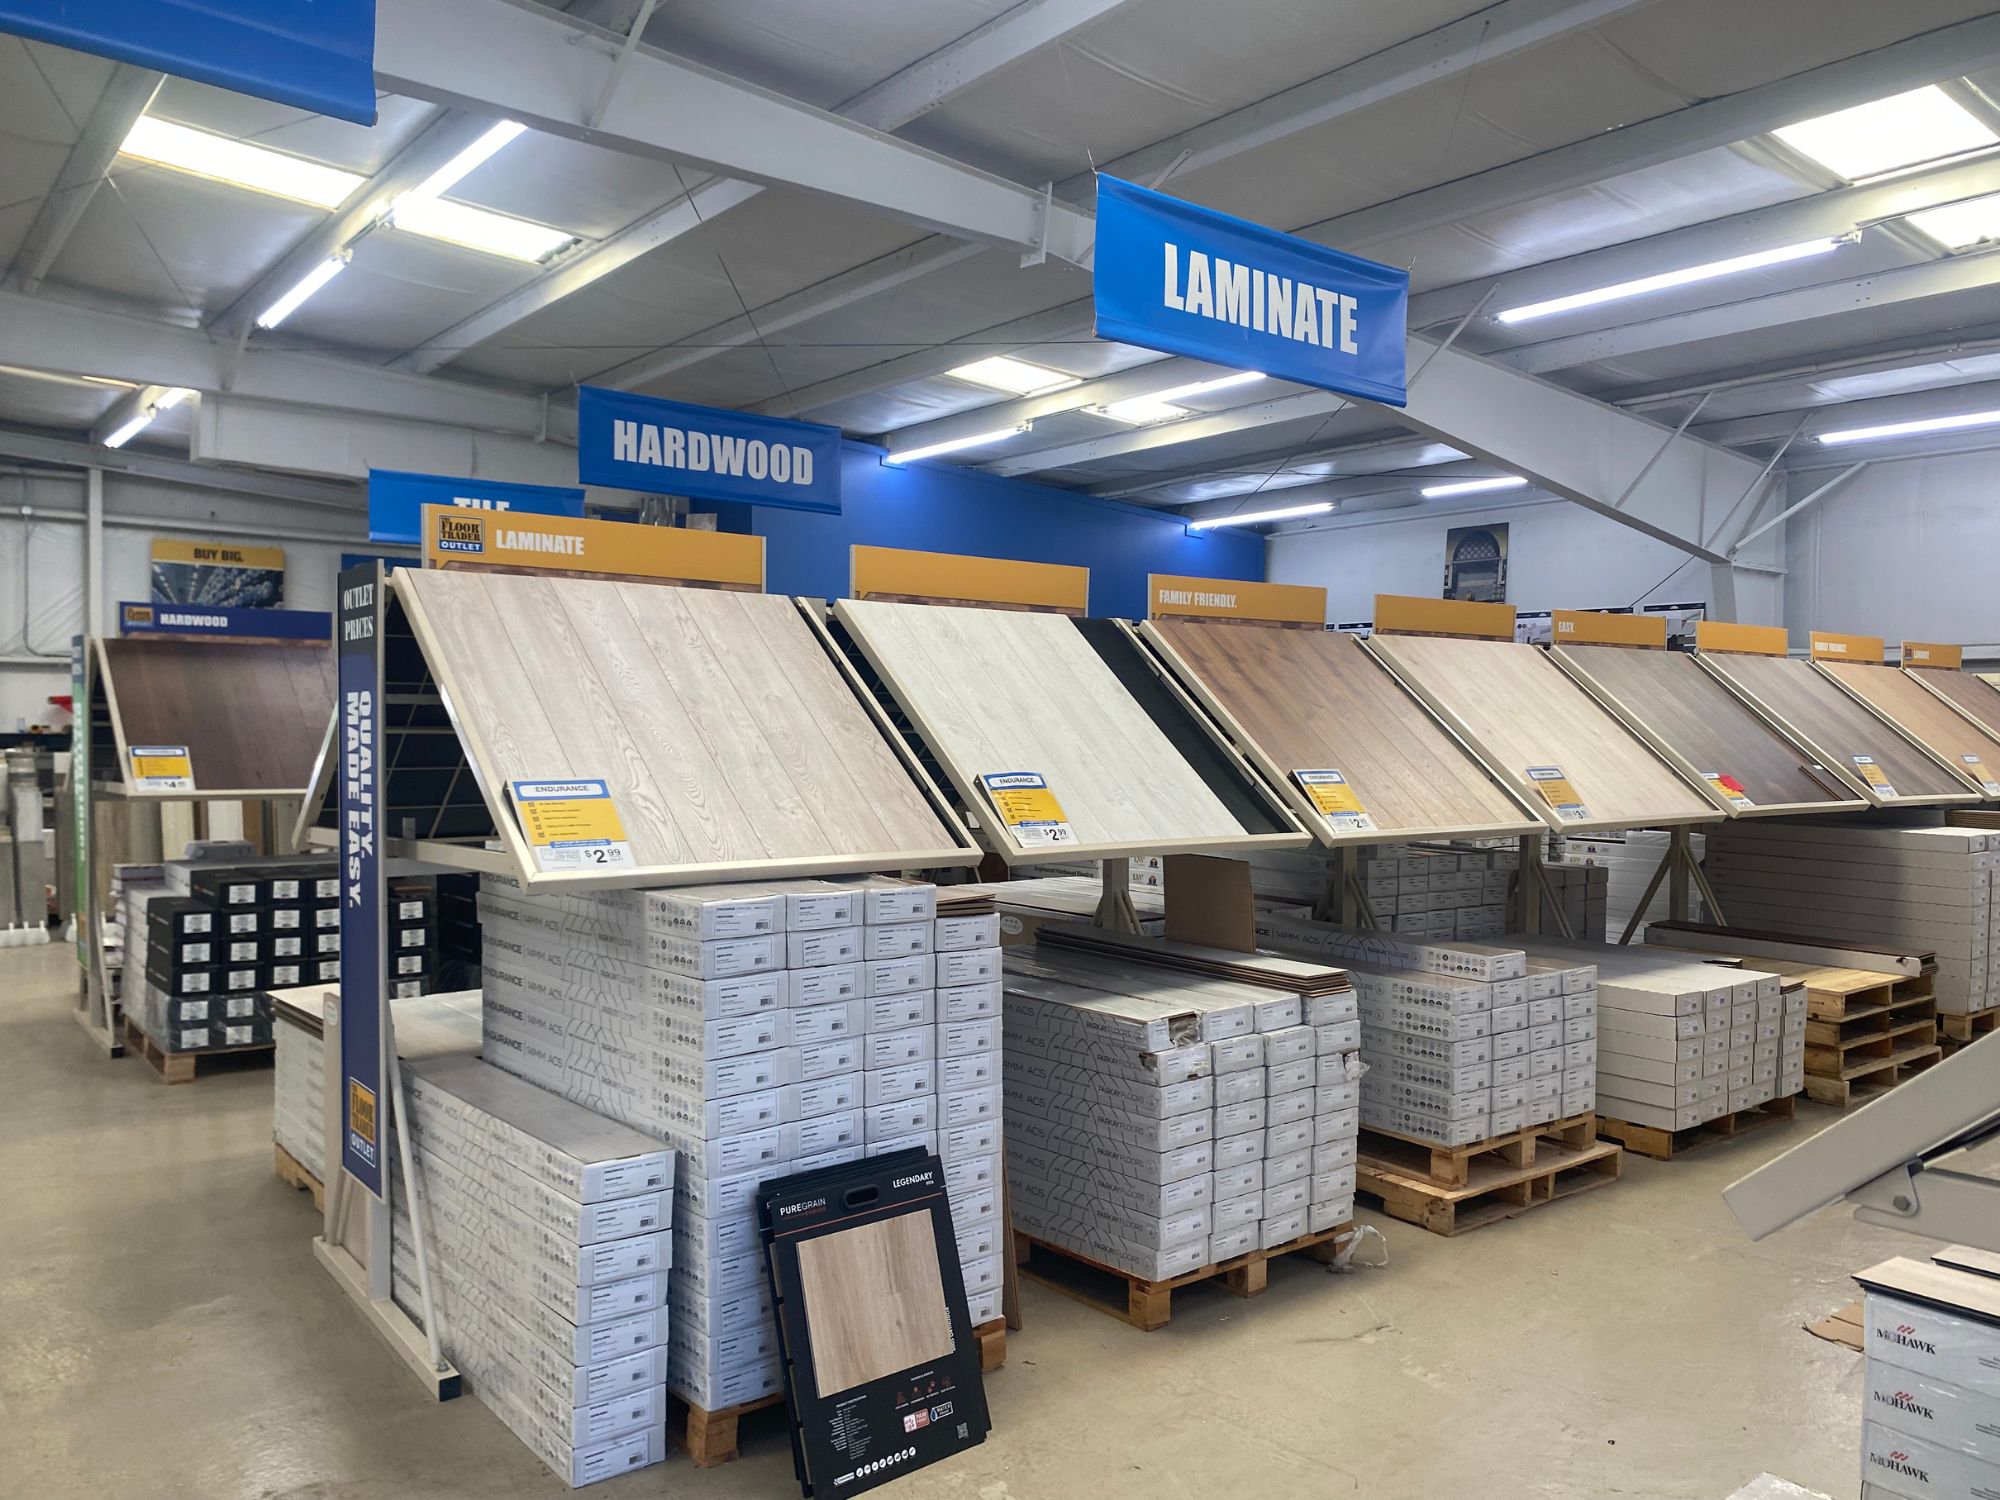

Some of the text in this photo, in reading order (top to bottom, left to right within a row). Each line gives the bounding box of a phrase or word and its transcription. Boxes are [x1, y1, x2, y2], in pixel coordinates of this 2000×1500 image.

[1163, 243, 1358, 355] LAMINATE
[613, 420, 815, 486] HARDWOOD
[441, 521, 480, 533] FLOOR
[441, 530, 481, 542] TRADER
[441, 541, 481, 551] OUTLET
[495, 529, 584, 555] LAMINATE
[194, 548, 218, 560] BUY
[343, 583, 374, 611] OUTLET
[1159, 589, 1237, 609] FAMILY FRIENDLY.
[160, 613, 228, 627] HARDWOOD
[344, 616, 374, 642] PRICES
[535, 785, 590, 793] ENDURANCE
[347, 692, 361, 908] MADE EASY.
[479, 903, 520, 921] ENDURANCE
[482, 935, 522, 954] ENDURANCE
[484, 966, 523, 987] ENDURANCE
[484, 999, 523, 1021] ENDURANCE
[485, 1029, 523, 1051] ENDURANCE
[351, 1133, 374, 1160] OUTLET
[892, 1171, 934, 1189] LEGENDARY
[779, 1197, 827, 1216] PUREGRAIN
[1876, 1327, 1936, 1355] MOHAWK
[1873, 1390, 1934, 1421] MOHAWK
[1869, 1452, 1929, 1483] MOHAWK
